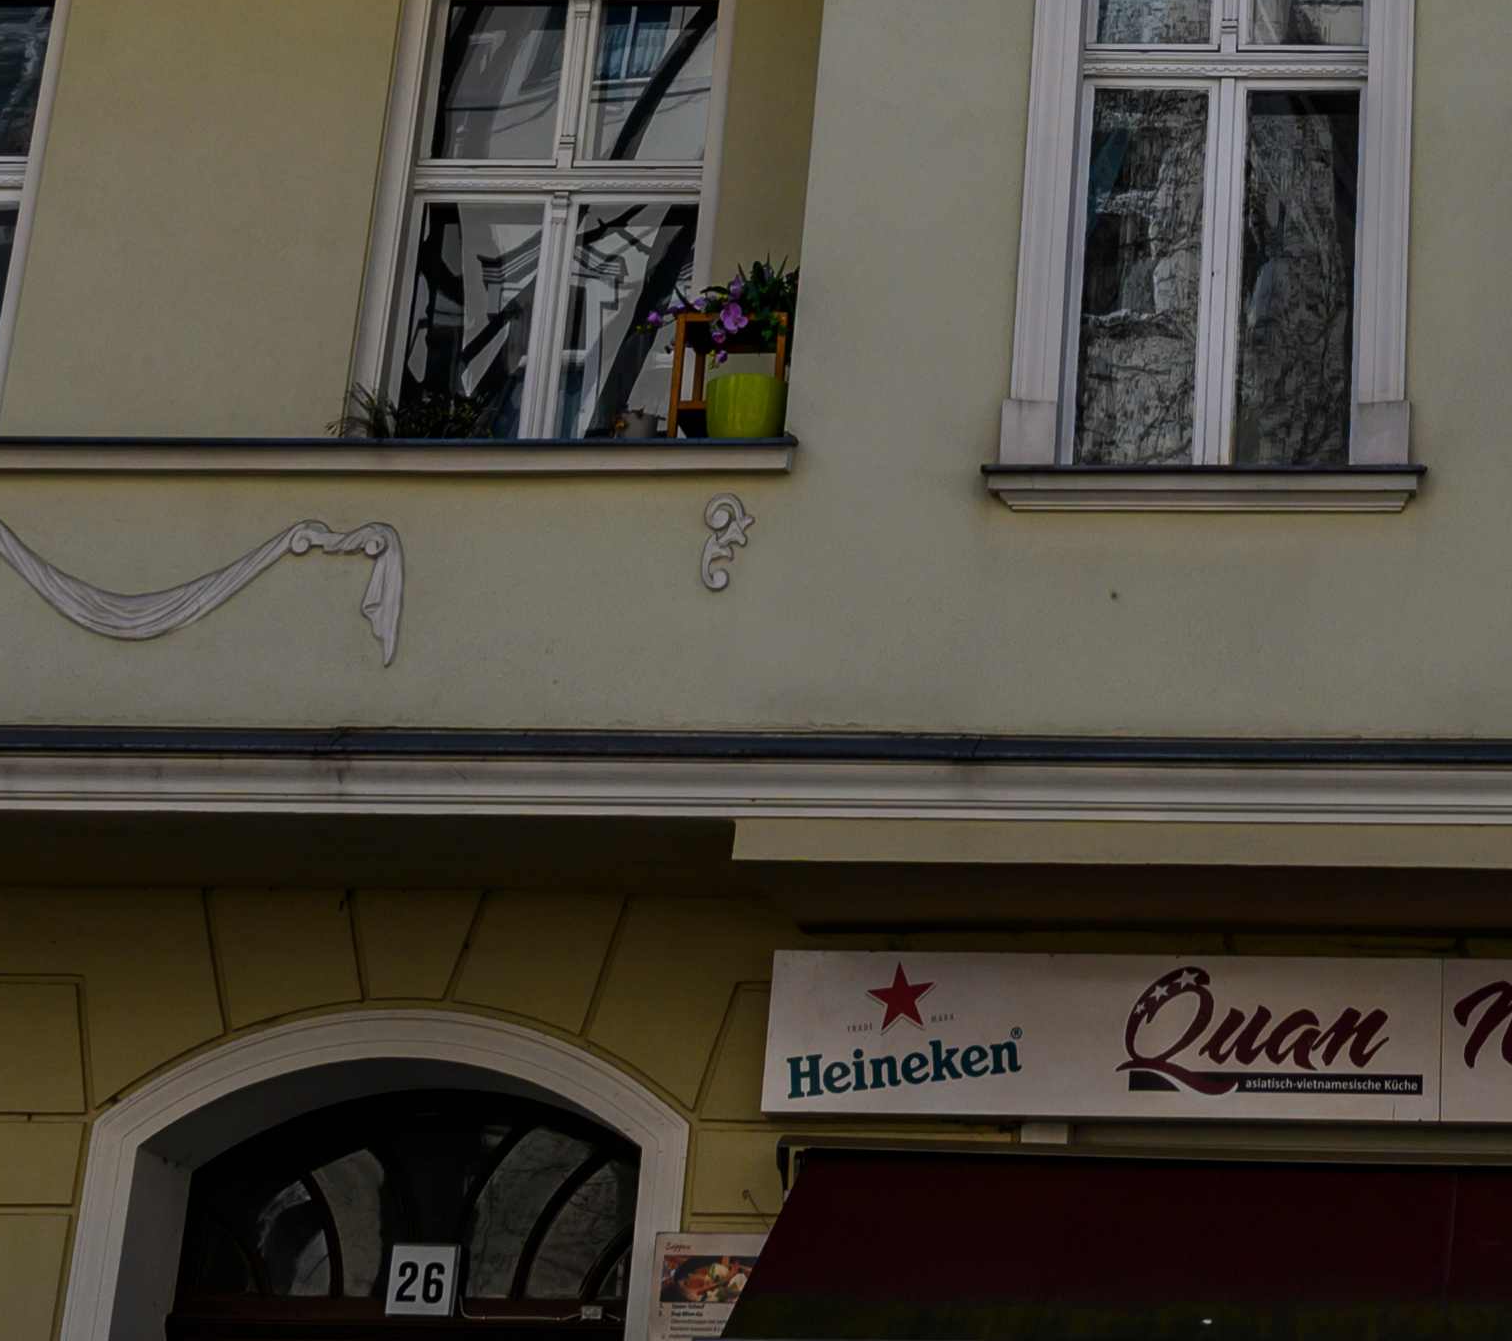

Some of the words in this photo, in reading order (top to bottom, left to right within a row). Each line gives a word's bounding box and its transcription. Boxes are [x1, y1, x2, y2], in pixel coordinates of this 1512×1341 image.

[1115, 966, 1390, 1095] Quan
[786, 1038, 1023, 1099] Heineken
[1245, 1076, 1382, 1092] asiatisch-vietnamesische
[1384, 1078, 1419, 1091] Küche
[395, 1260, 445, 1304] 26
